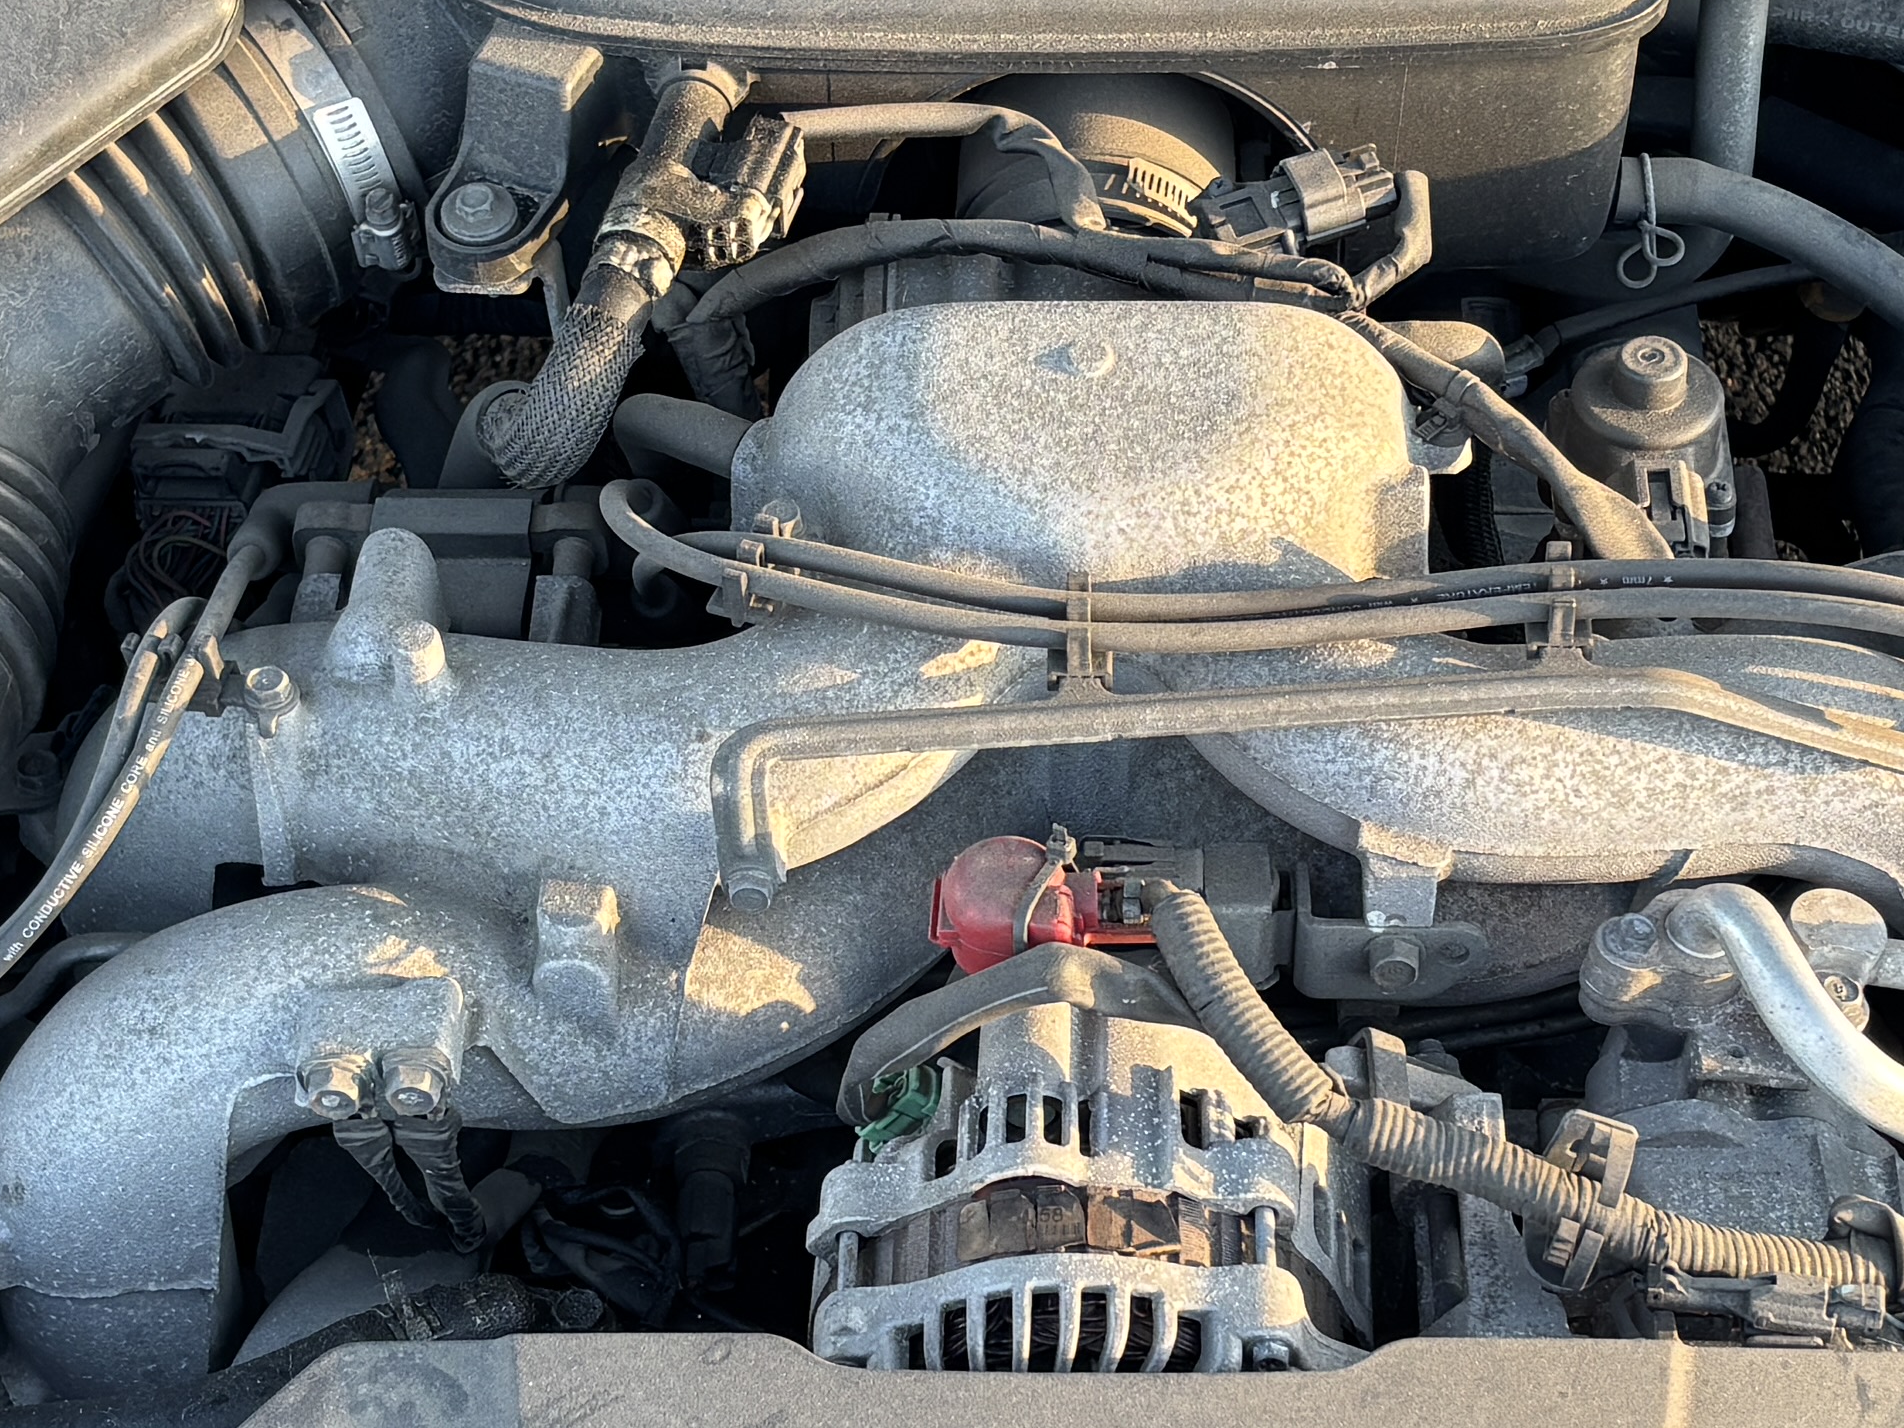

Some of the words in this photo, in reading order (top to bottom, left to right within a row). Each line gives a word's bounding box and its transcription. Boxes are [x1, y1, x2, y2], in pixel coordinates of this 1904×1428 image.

[2, 941, 25, 964] with
[21, 859, 86, 940] CONDUCTIVE
[81, 798, 126, 861] SILICONE
[120, 754, 148, 795] CORE
[144, 728, 163, 755] and
[156, 672, 191, 725] SILICONE
